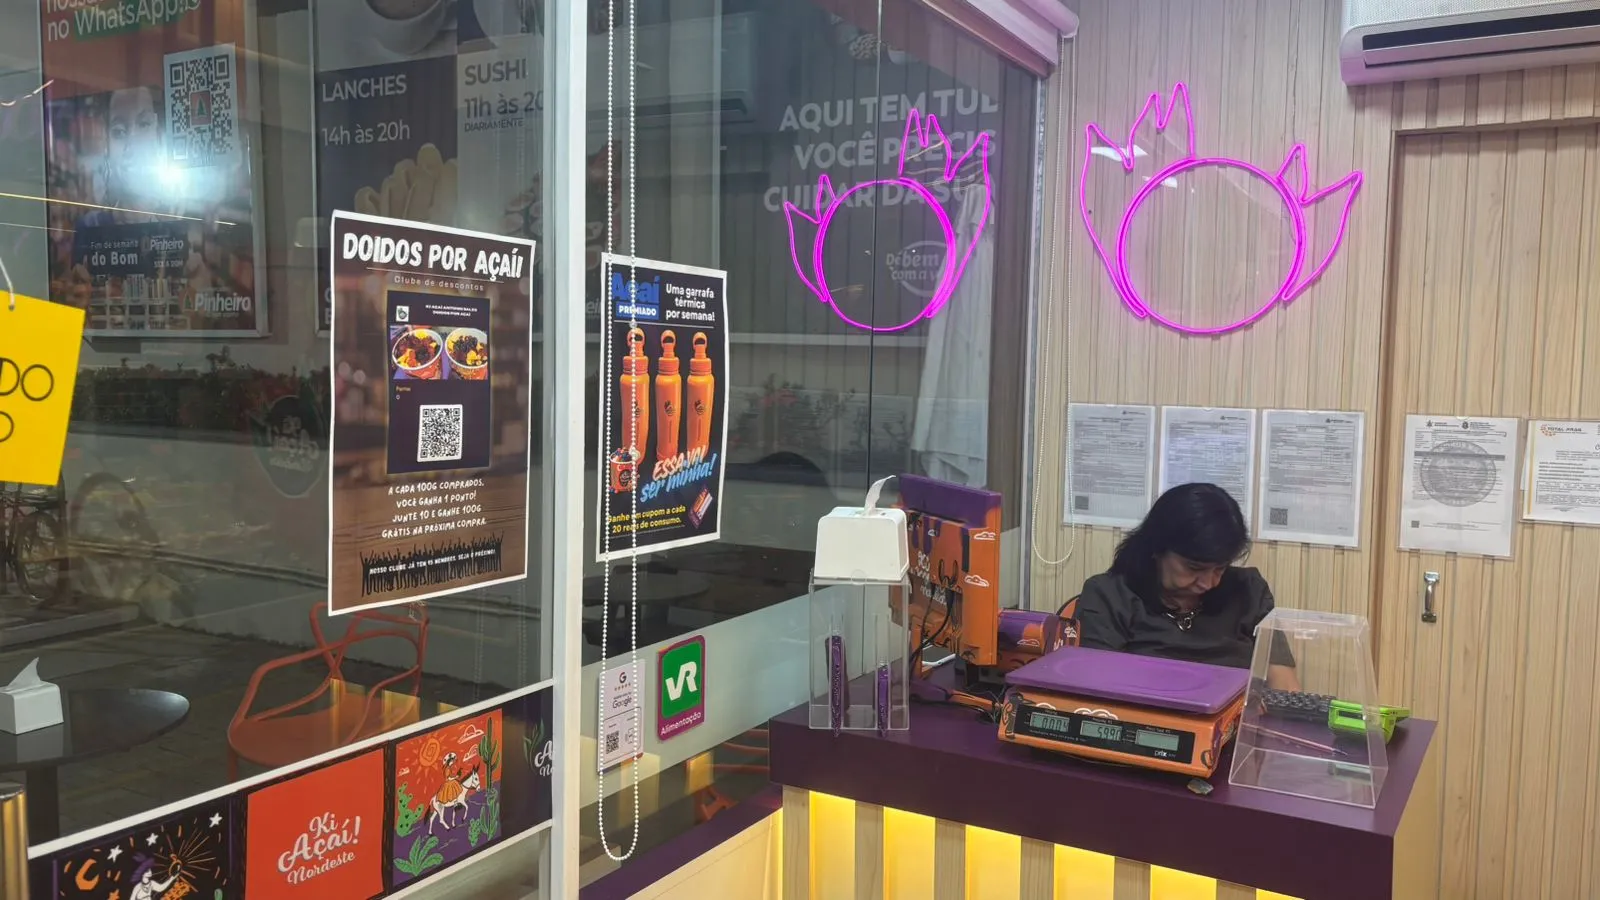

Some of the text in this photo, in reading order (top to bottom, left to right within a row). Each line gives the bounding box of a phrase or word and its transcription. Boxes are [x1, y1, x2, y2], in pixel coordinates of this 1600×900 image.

[47, 20, 70, 42] no
[74, 0, 178, 36] WhatsApp
[464, 58, 528, 86] SUSHI
[321, 75, 408, 102] LANCHES
[464, 90, 544, 118] 11h às 20
[778, 99, 853, 132] AQUI
[860, 91, 926, 123] TEM
[322, 119, 411, 146] 14h às 20h
[464, 117, 524, 133] DIARIAMENTE
[793, 131, 875, 170] VOCÊ
[763, 184, 875, 212] CUIDAR
[150, 237, 184, 250] Pinheiro
[91, 251, 139, 266] do Bom
[343, 232, 524, 281] DOIDOS POR AÇAÍ!
[394, 275, 484, 291] Clube de descontos
[665, 283, 685, 295] Uma
[685, 287, 715, 299] garrafa
[194, 292, 251, 312] Pinheiro
[674, 297, 706, 309] térmica
[665, 310, 680, 321] por
[681, 310, 715, 322] semana!
[652, 445, 707, 481] ESSA VAI
[388, 486, 393, 495] A
[395, 484, 415, 494] CADA
[417, 482, 437, 492] 100G
[640, 452, 718, 503] ser minha!
[396, 489, 477, 508] VOCÊ GANHA 1 PONTO!
[392, 504, 482, 523] JUNTE 10 E GANHE 100G
[642, 509, 665, 518] cupom
[671, 505, 686, 514] cada
[381, 527, 411, 538] GRÁTIS
[412, 526, 423, 536] NA
[424, 521, 455, 534] PRÓXIMA
[612, 525, 622, 534] 20
[623, 523, 639, 532] reas
[640, 520, 649, 528] de
[660, 711, 702, 736] Alimentação
[309, 811, 339, 840] Ki
[277, 815, 361, 873] Açaí!
[287, 851, 356, 885] Nordeste
